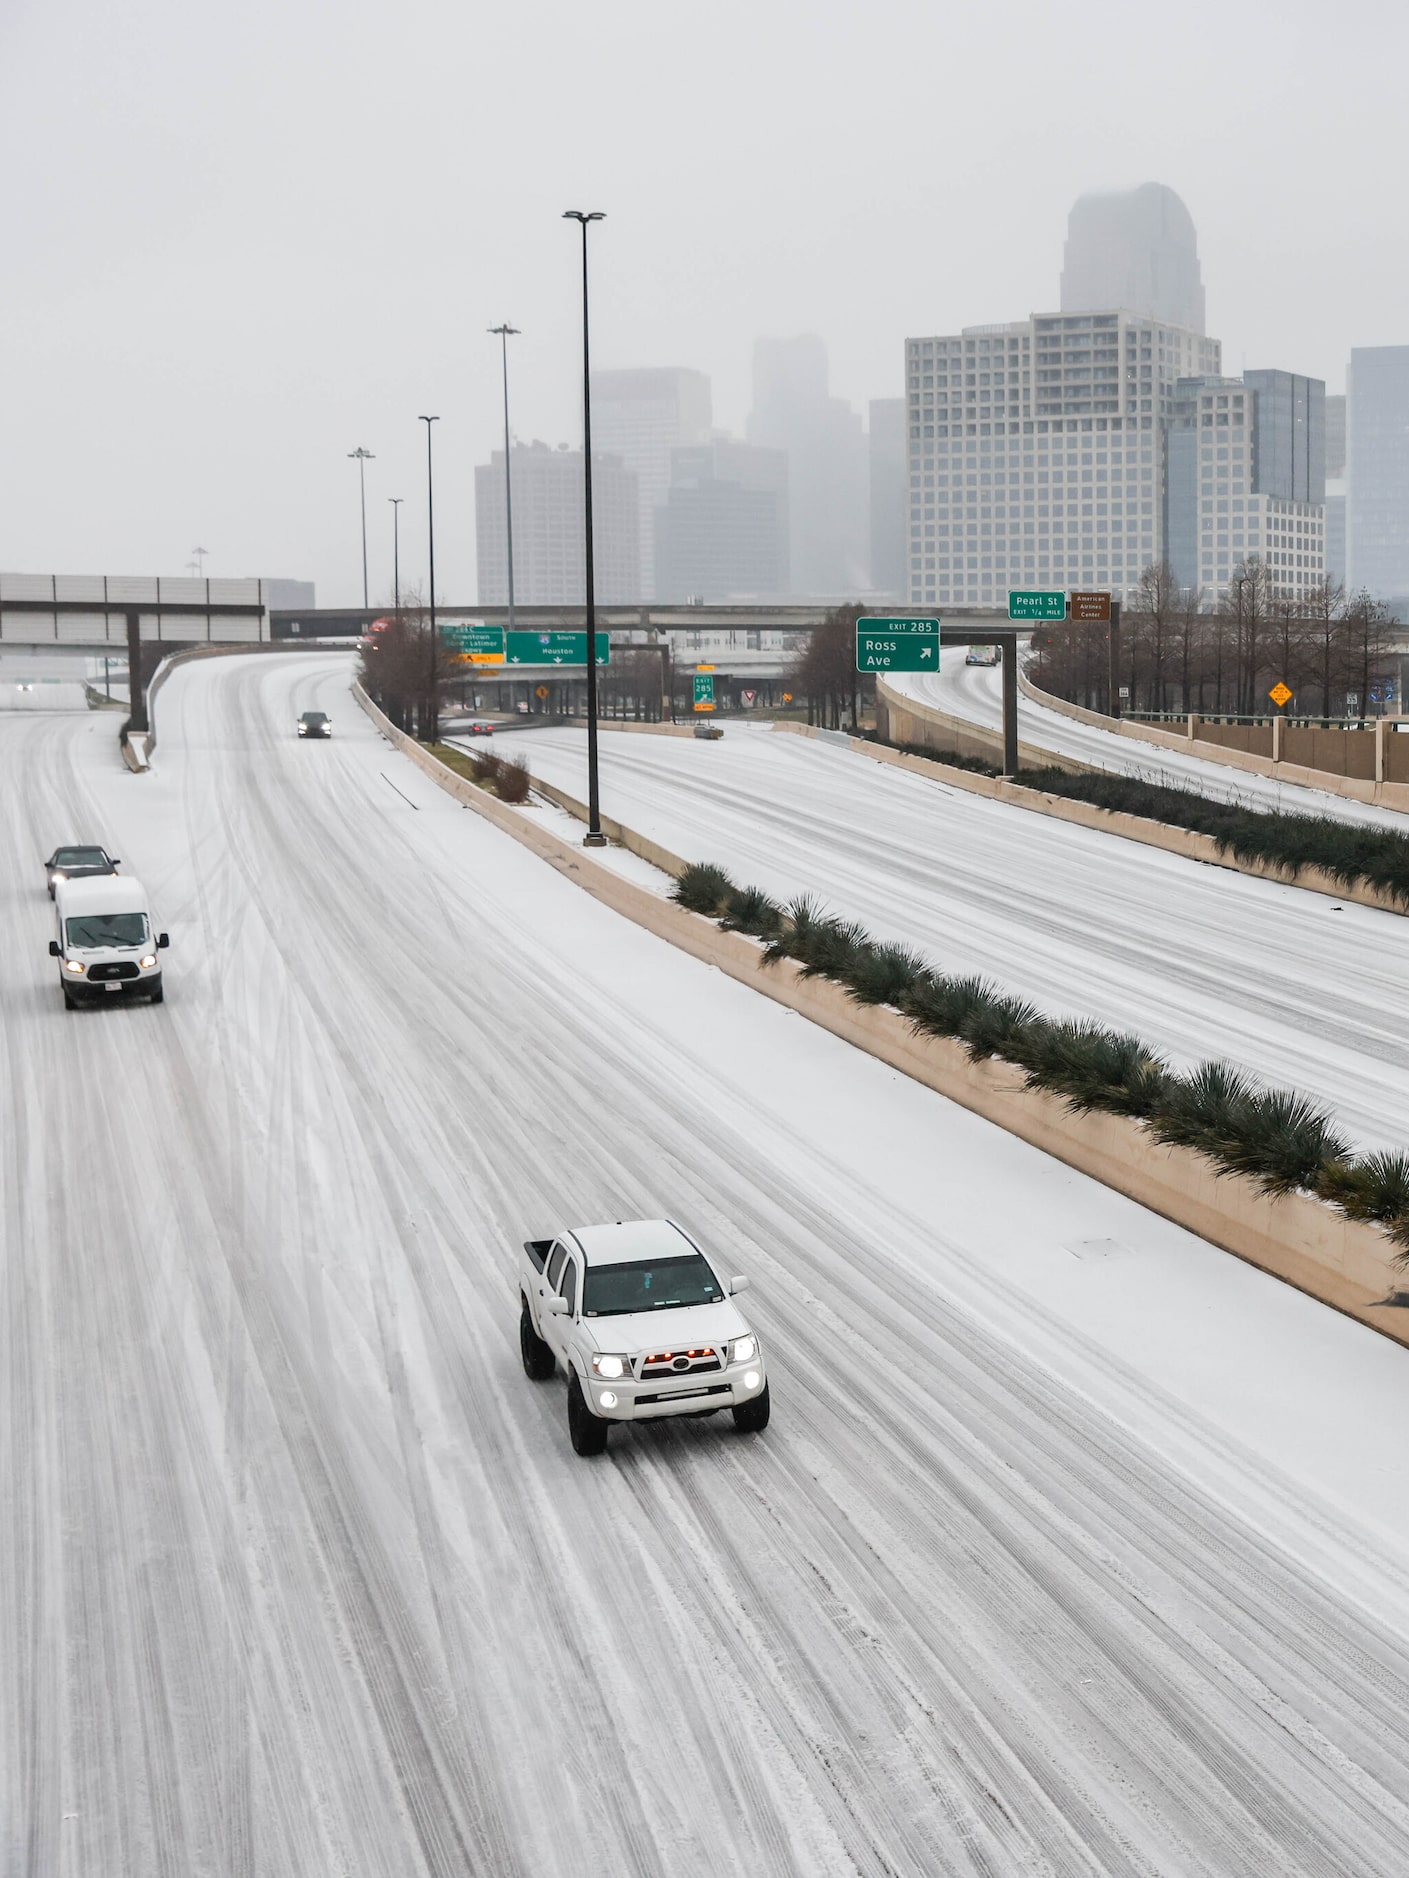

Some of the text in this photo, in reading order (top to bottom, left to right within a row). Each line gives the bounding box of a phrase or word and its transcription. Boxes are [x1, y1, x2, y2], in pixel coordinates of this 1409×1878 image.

[1016, 596, 1058, 606] Pearl St
[1031, 608, 1042, 616] 1/4
[910, 622, 932, 632] 285
[865, 640, 897, 651] Ross
[866, 655, 891, 666] Ave
